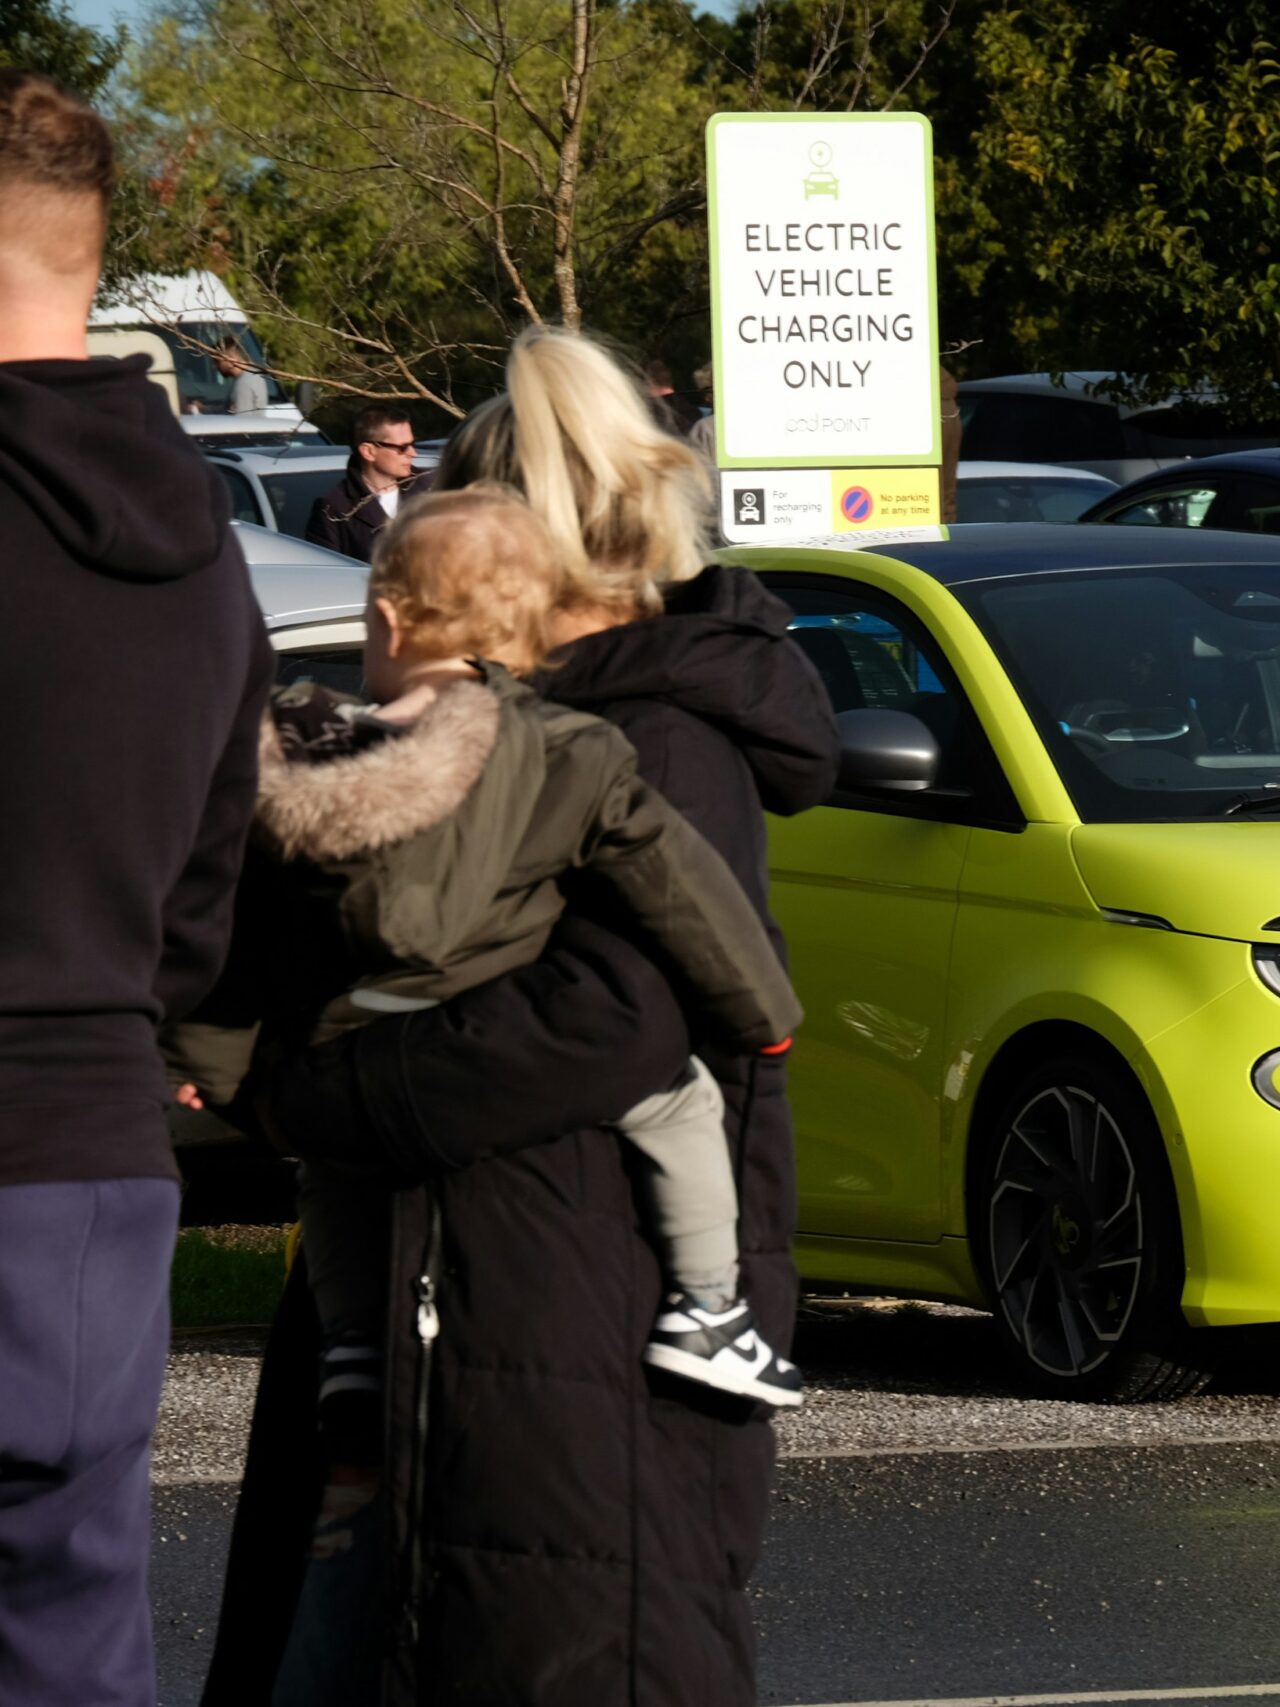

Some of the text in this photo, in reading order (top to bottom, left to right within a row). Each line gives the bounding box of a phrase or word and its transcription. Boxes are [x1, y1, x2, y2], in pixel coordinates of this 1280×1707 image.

[746, 223, 901, 251] ELECTRIC
[755, 268, 893, 296] VEHICLE
[738, 313, 913, 343] CHARGING
[783, 360, 871, 389] ONLY
[822, 417, 872, 432] POINT
[772, 490, 788, 499] For
[880, 493, 929, 504] No parking
[773, 503, 822, 512] recharging
[880, 506, 930, 516] at any time
[773, 515, 792, 525] only
